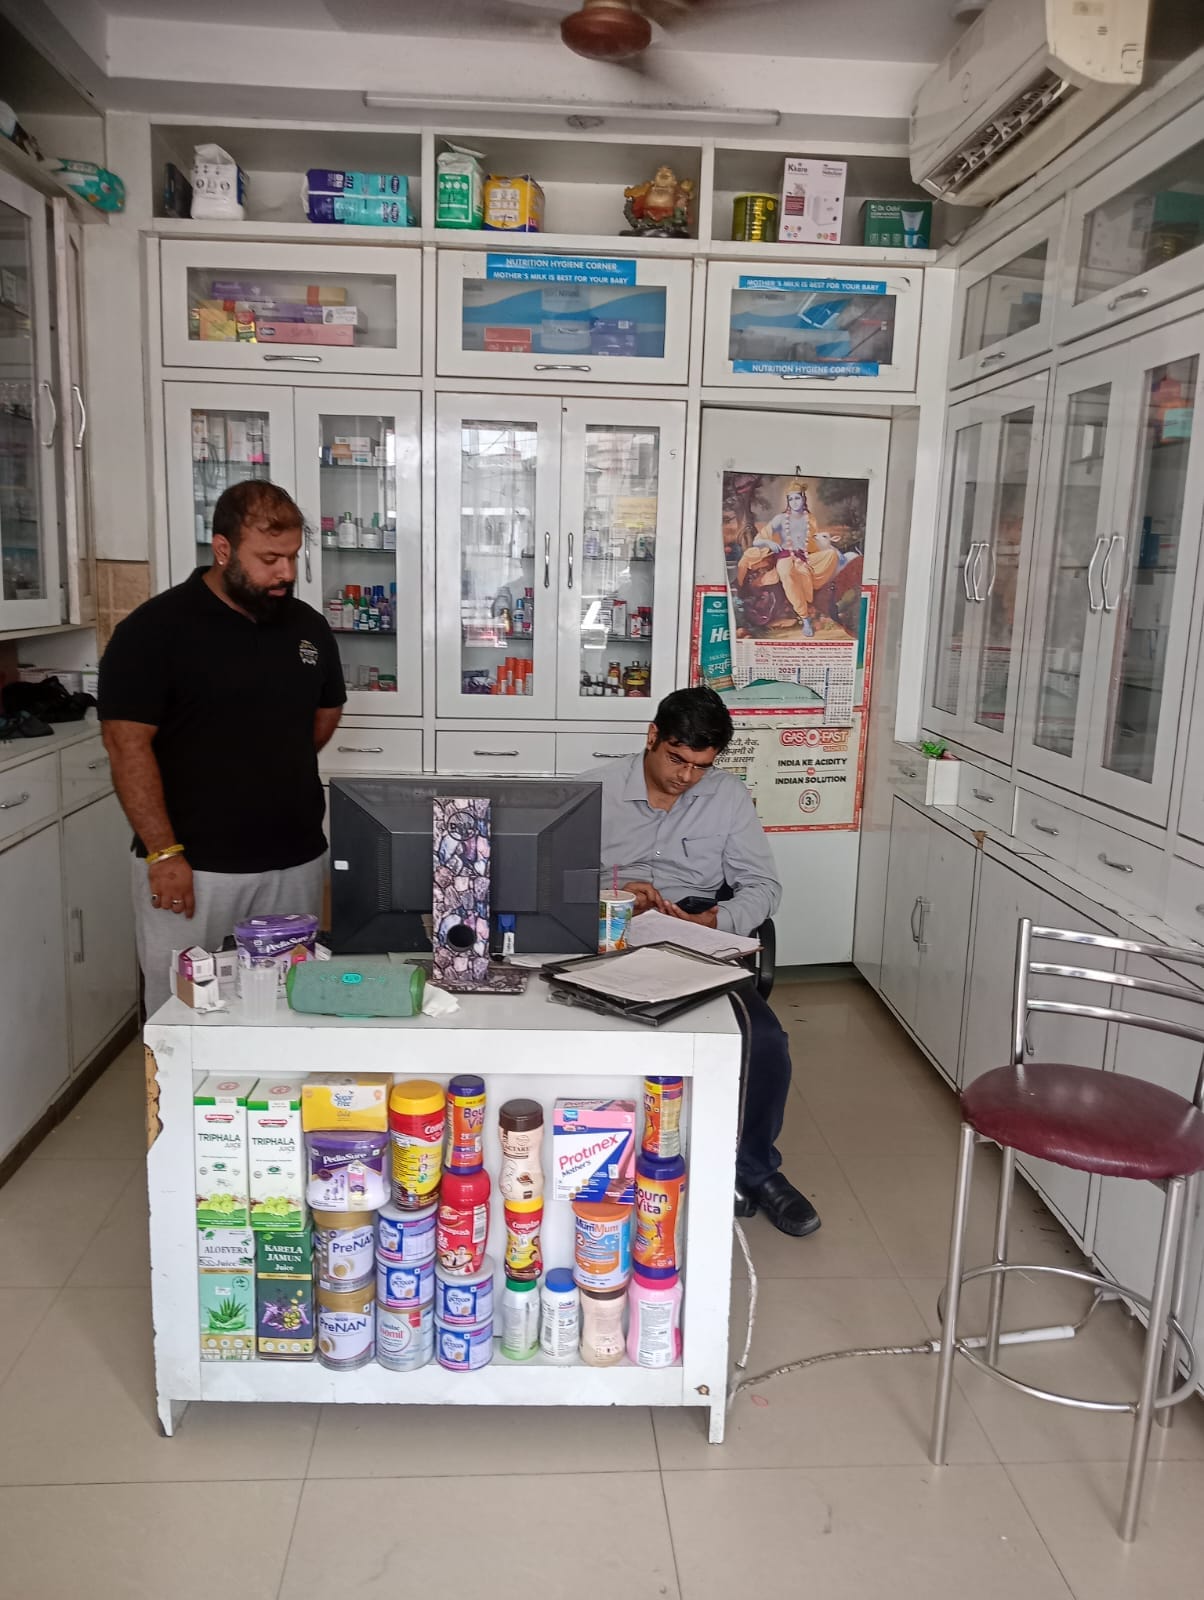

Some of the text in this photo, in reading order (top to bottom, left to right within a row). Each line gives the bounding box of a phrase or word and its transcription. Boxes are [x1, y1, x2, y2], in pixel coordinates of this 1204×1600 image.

[506, 258, 617, 270] NUTRITION HYGIENE CORNER
[493, 271, 529, 280] MOTHER'S
[531, 273, 547, 281] MILK
[557, 274, 572, 282] BEST
[574, 275, 587, 283] FOR
[590, 276, 609, 284] YOUR
[610, 277, 629, 285] BABY
[747, 278, 782, 287] MOTHER'S
[784, 280, 800, 288] MILK
[752, 364, 861, 374] NUTRITION HYGIENE CORNER
[709, 627, 731, 643] He
[778, 759, 800, 767] INDIA
[815, 758, 848, 766] ACIDITY
[805, 775, 847, 784] SOLUTION
[334, 1093, 354, 1102] Sugar
[464, 1107, 486, 1119] Bou
[198, 1133, 241, 1142] TRIPHALA
[251, 1137, 295, 1146] TRIPHALA
[558, 1134, 619, 1170] Protinex
[323, 1152, 367, 1165] PediaSure
[264, 1244, 304, 1254] KARELA
[266, 1253, 302, 1262] JAMUN
[217, 1259, 237, 1267] Juice
[274, 1263, 295, 1271] Juice
[320, 1318, 367, 1333] PreNAN
